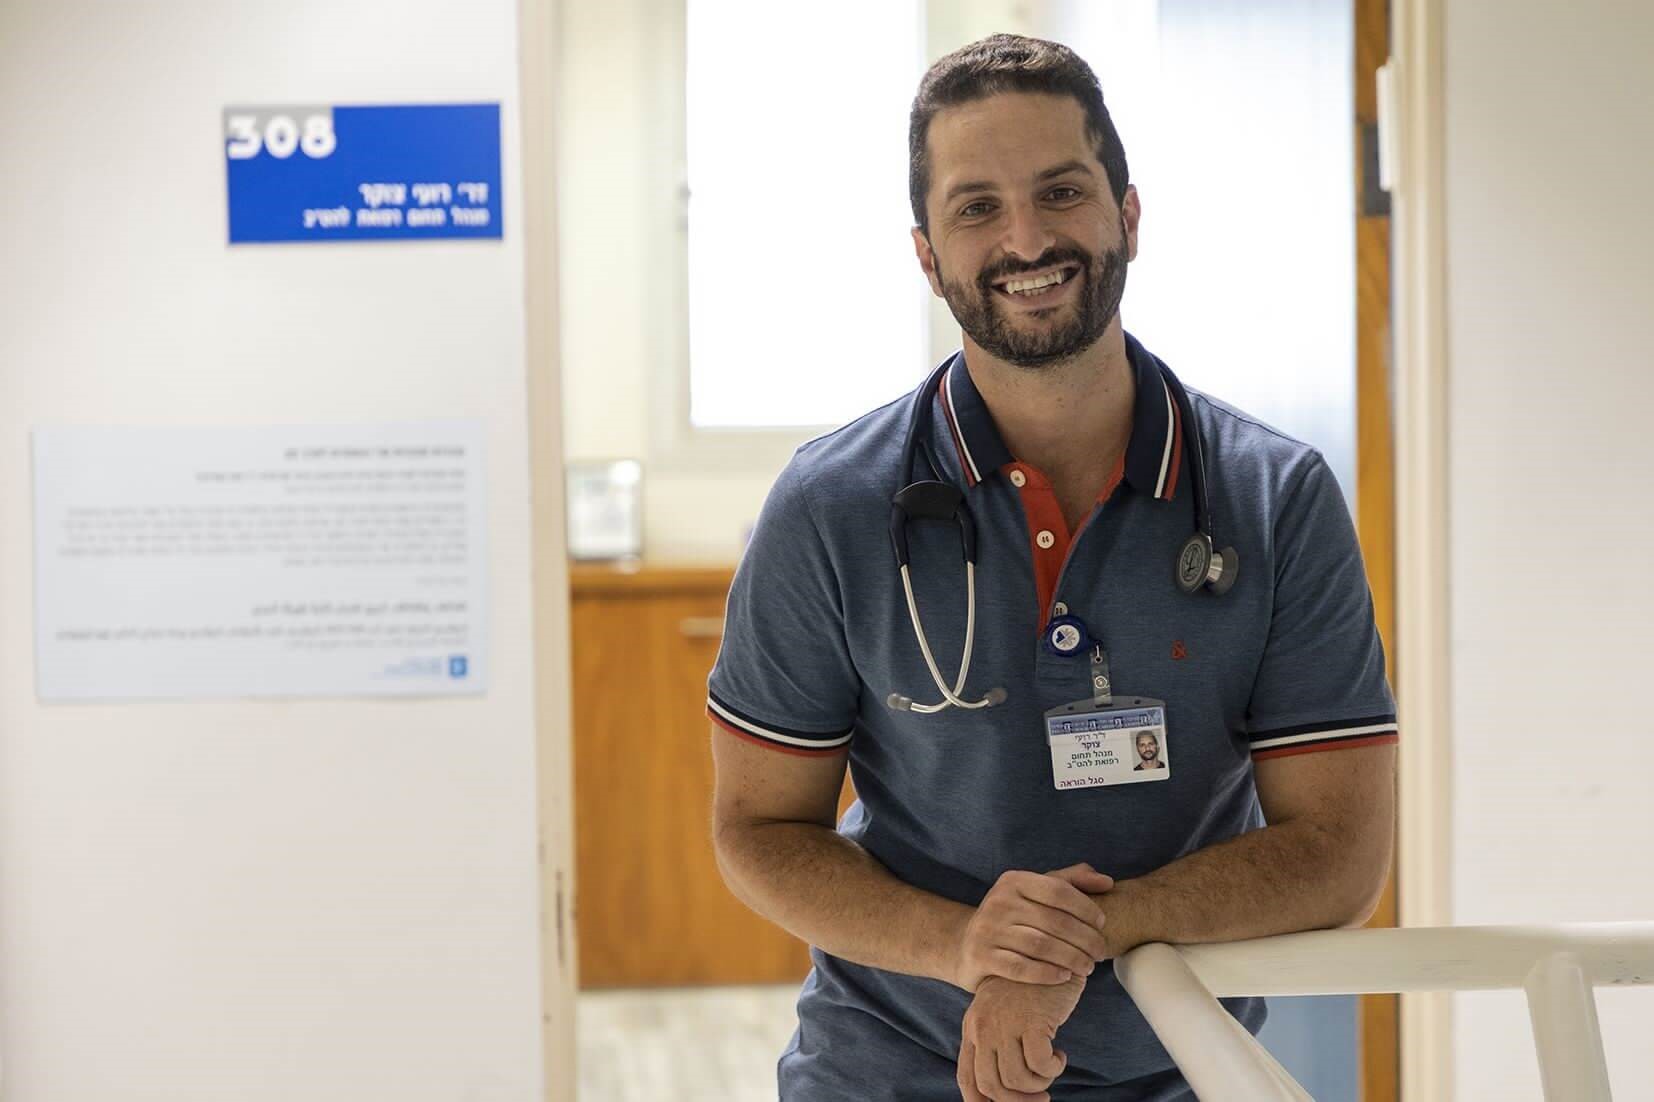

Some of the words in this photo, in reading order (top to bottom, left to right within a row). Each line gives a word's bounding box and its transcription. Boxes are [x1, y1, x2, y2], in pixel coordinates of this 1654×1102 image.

[226, 115, 337, 159] 308
[411, 182, 452, 206] רועי
[1074, 734, 1091, 743] רועי
[1081, 741, 1101, 751] צוקר
[1071, 752, 1091, 760] תחום
[1093, 750, 1113, 758] מנהל
[1067, 759, 1093, 769] להט"ב
[1095, 758, 1119, 766] רפואת
[1060, 778, 1086, 788] הוראה
[1088, 776, 1104, 784] סגל
